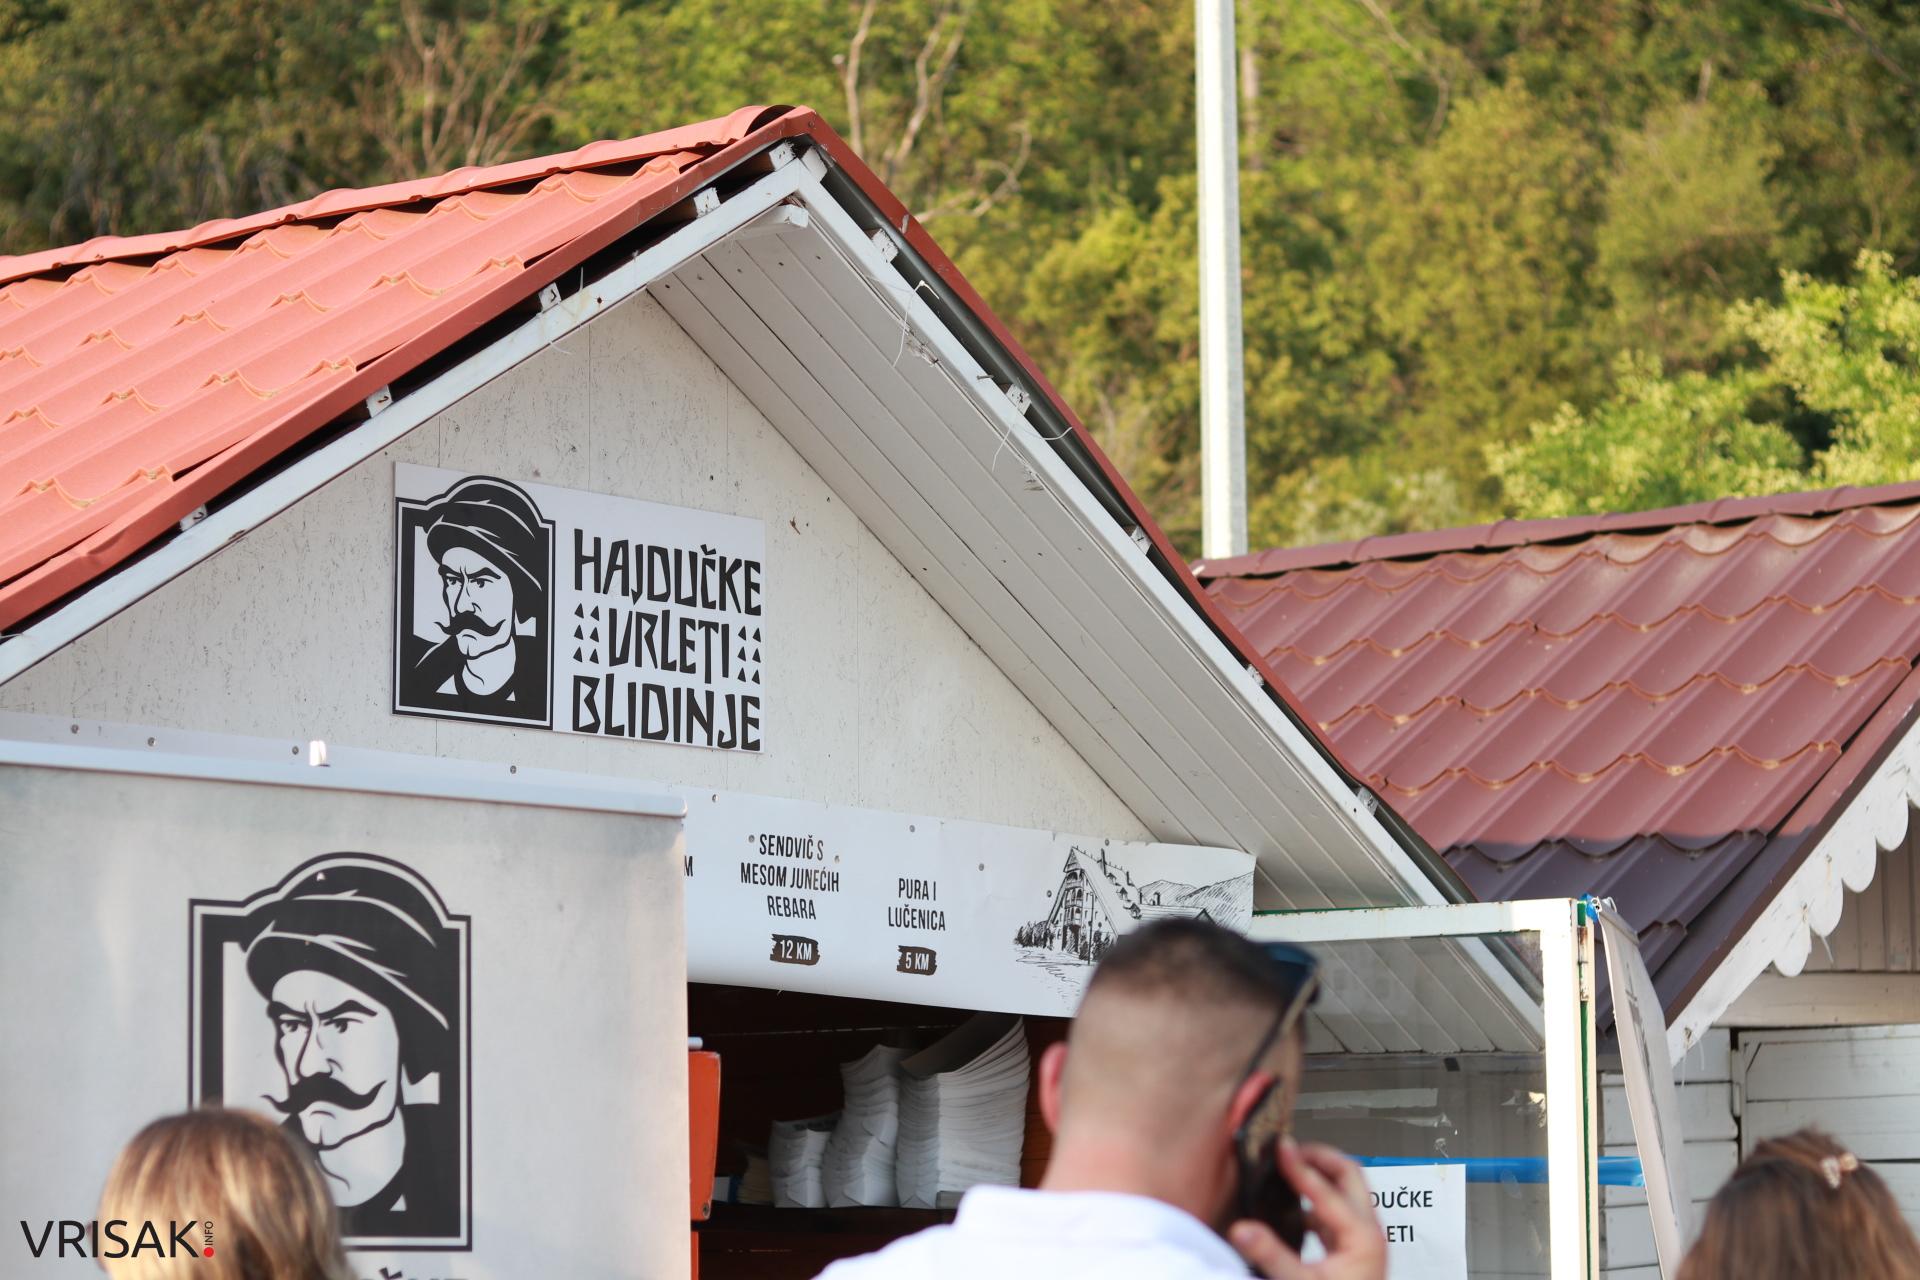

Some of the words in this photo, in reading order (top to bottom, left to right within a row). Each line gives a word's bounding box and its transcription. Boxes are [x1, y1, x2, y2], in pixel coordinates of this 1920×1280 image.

[574, 528, 761, 616] HAJDUČKE
[608, 607, 730, 684] VRLETI
[572, 673, 761, 751] BLIDINJE
[759, 833, 814, 860] SENDVIČ
[817, 840, 824, 861] S
[740, 862, 787, 887] MESOM
[790, 866, 839, 892] JUNEĆIH
[898, 877, 929, 901] PURA
[767, 895, 817, 920] REBARA
[888, 904, 946, 931] LUČENICA
[780, 940, 794, 959] 12
[796, 942, 812, 961] KM
[905, 952, 912, 969] 5
[914, 953, 930, 971] KM
[1369, 1186, 1433, 1208] DUČKE
[1386, 1225, 1414, 1242] ETI
